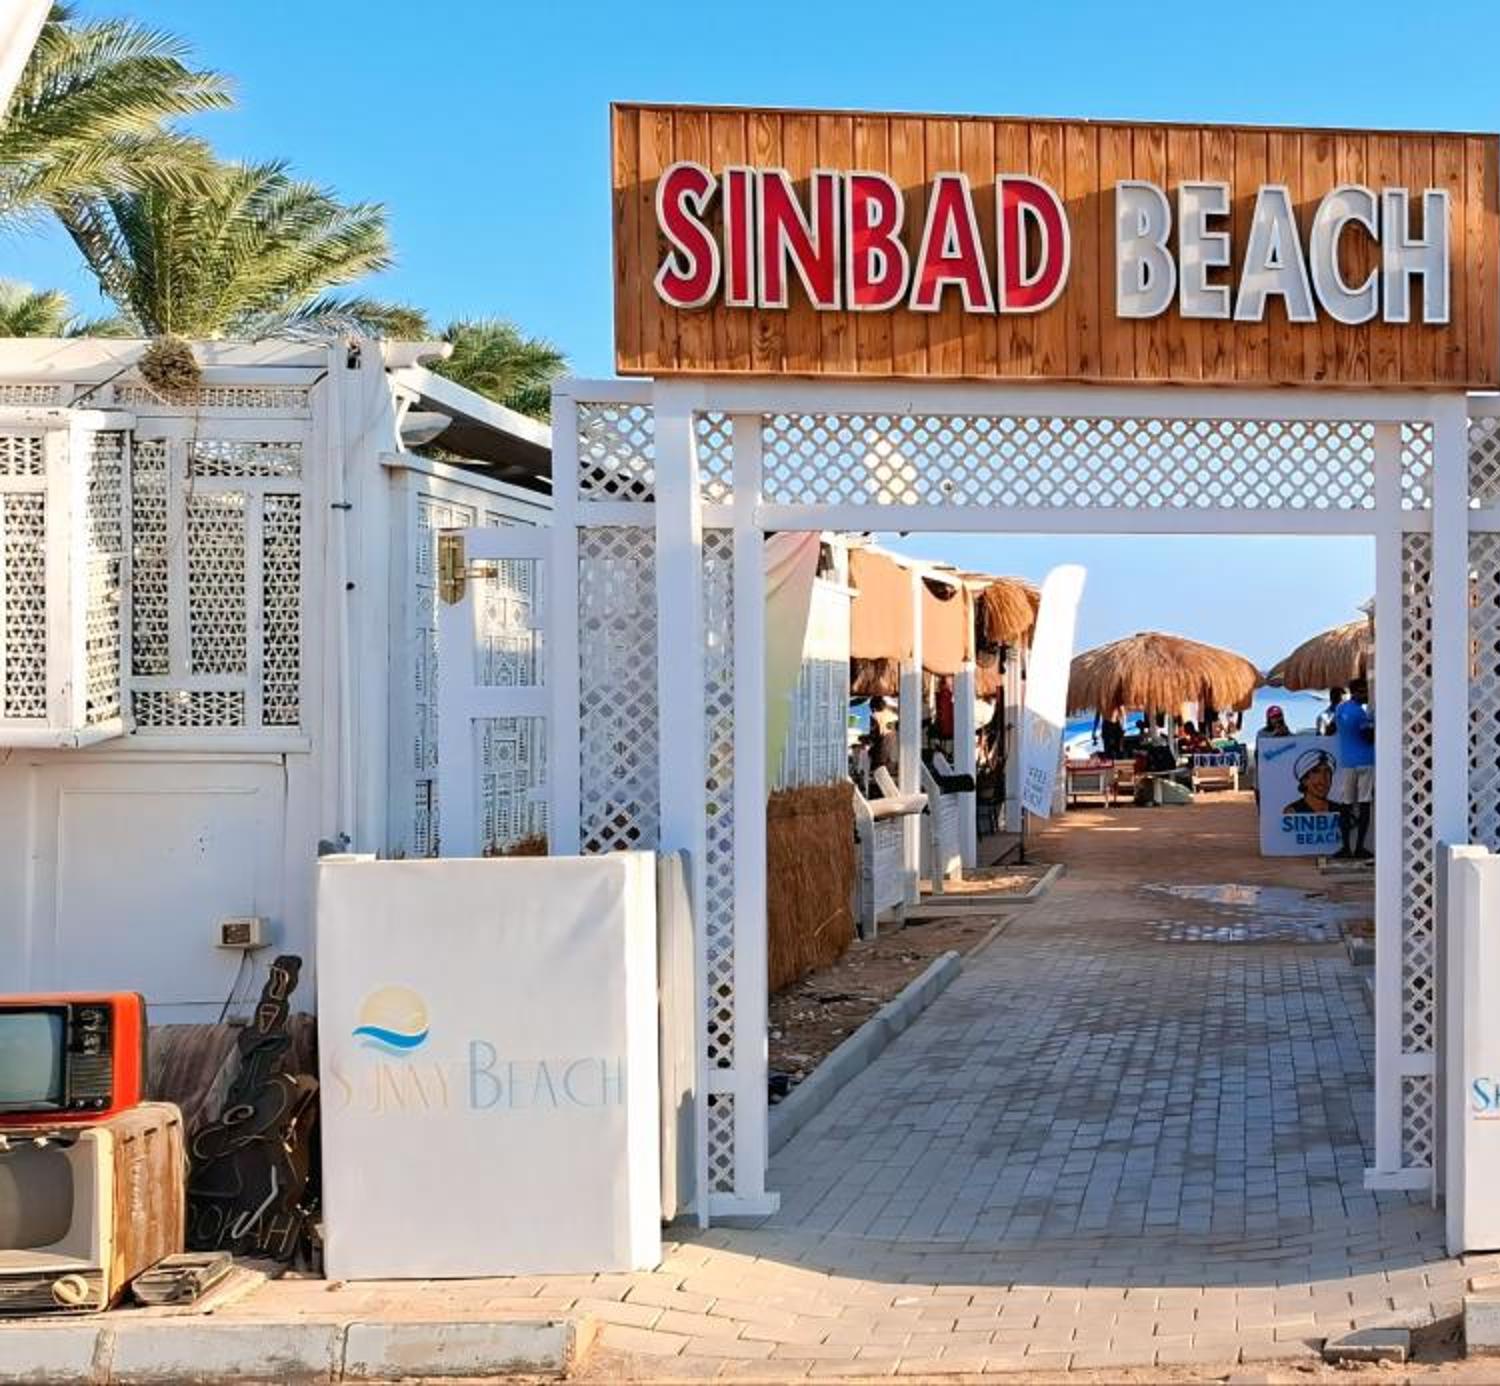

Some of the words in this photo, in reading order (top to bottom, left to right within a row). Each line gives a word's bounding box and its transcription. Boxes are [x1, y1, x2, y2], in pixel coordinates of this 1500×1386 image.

[654, 161, 1071, 313] SINBAD
[1115, 179, 1451, 325] BEACH
[1281, 814, 1344, 832] SINBA
[468, 1038, 624, 1110] BEACH
